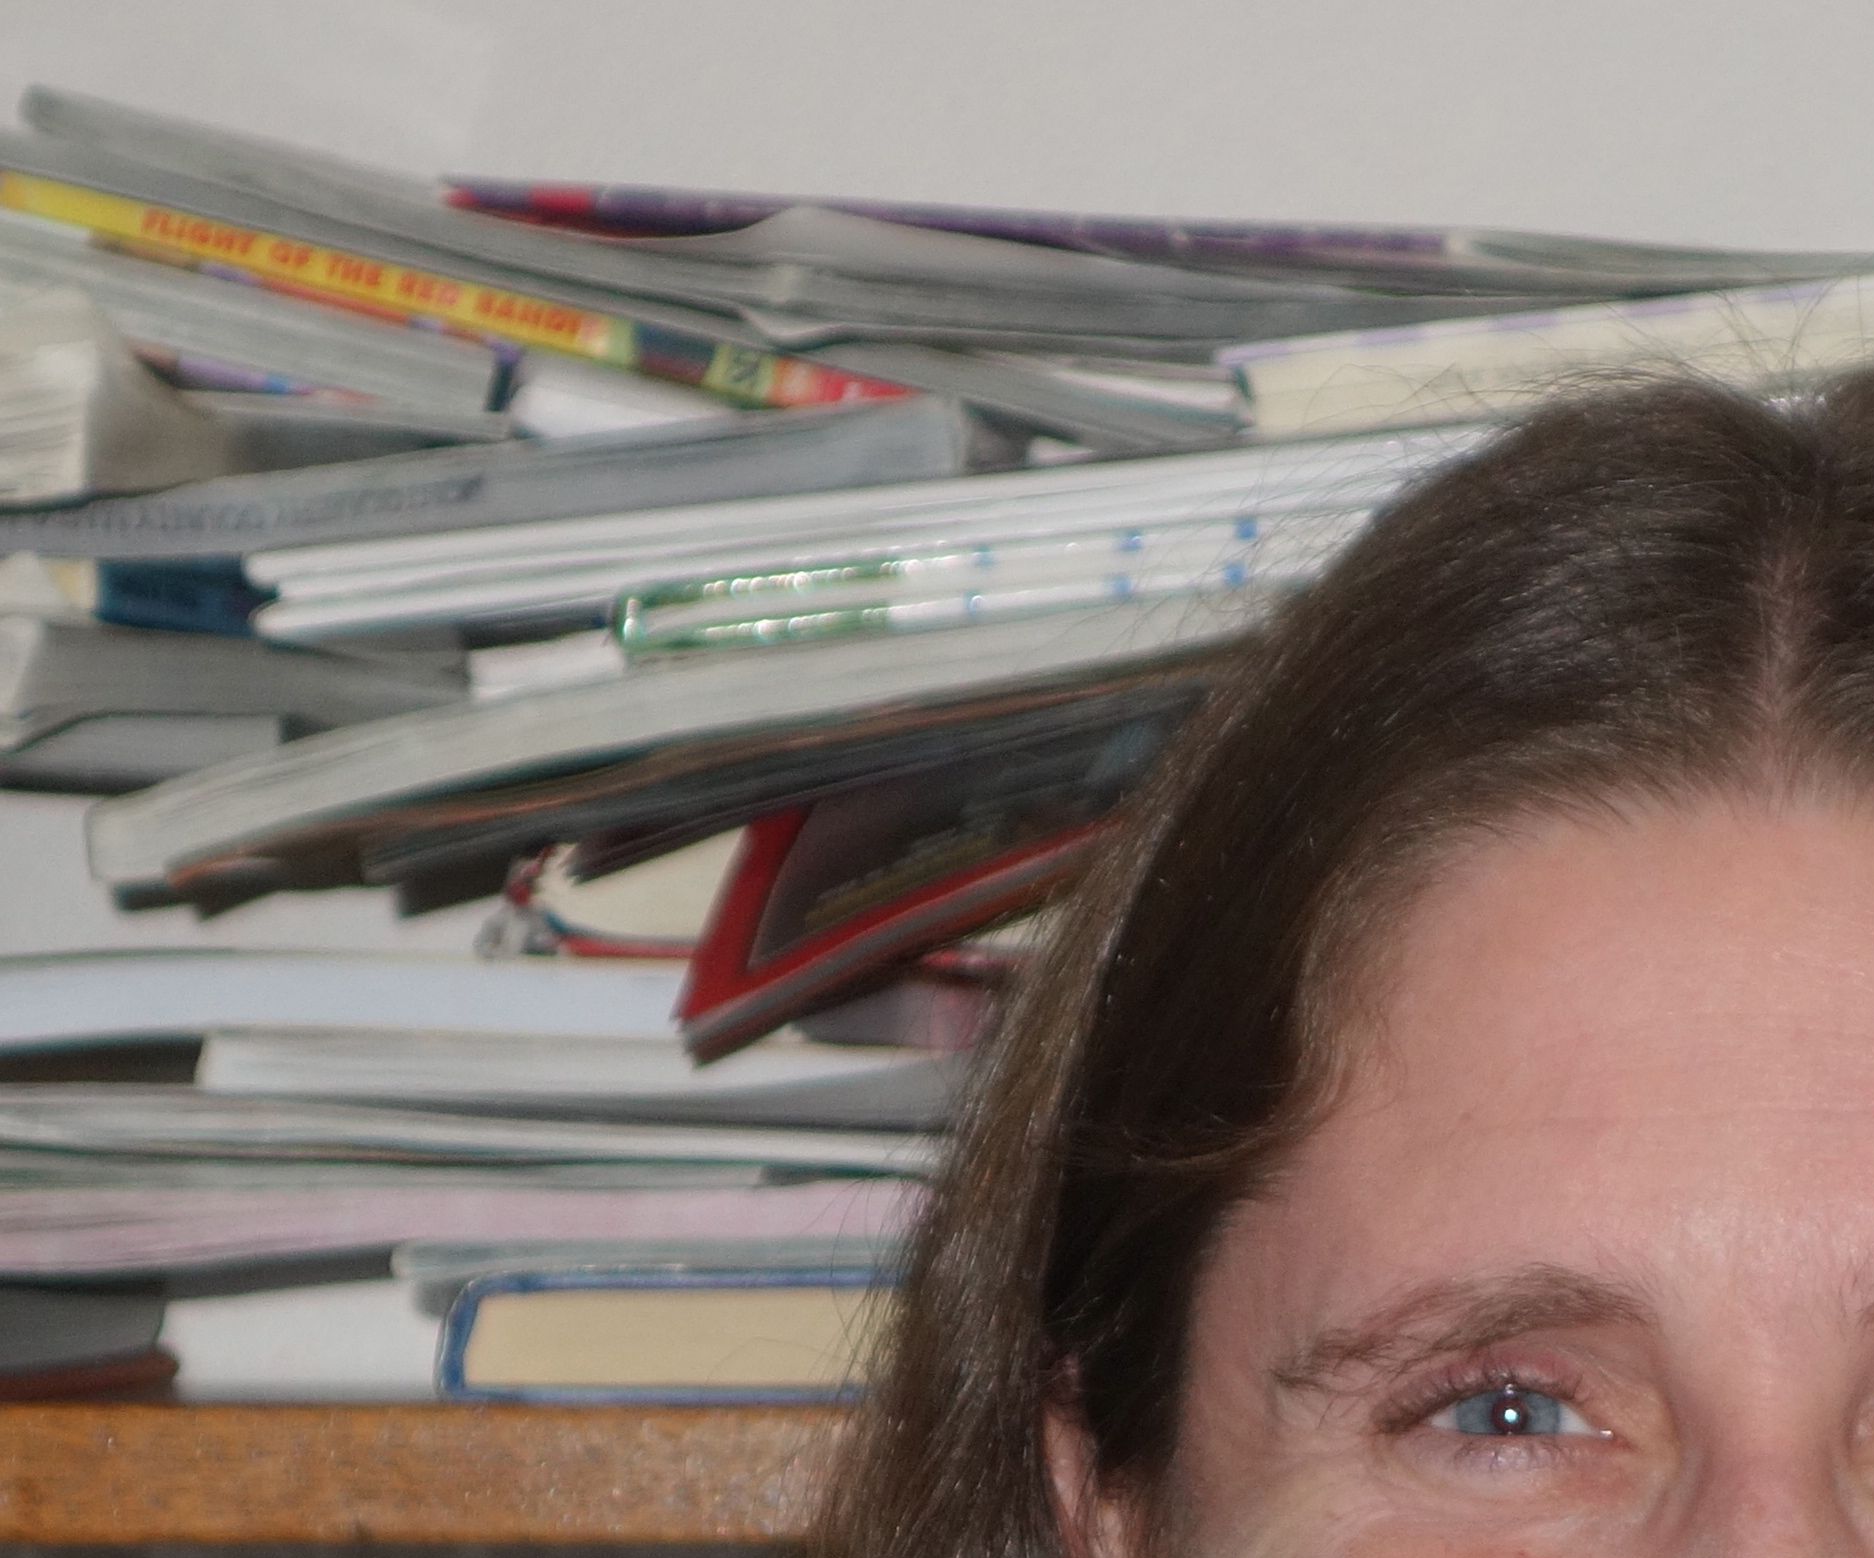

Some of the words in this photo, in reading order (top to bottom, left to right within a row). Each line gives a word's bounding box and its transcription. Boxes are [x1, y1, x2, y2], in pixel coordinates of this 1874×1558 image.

[141, 206, 258, 255] FLIGHT
[269, 240, 313, 269] OF
[325, 254, 384, 287] THE
